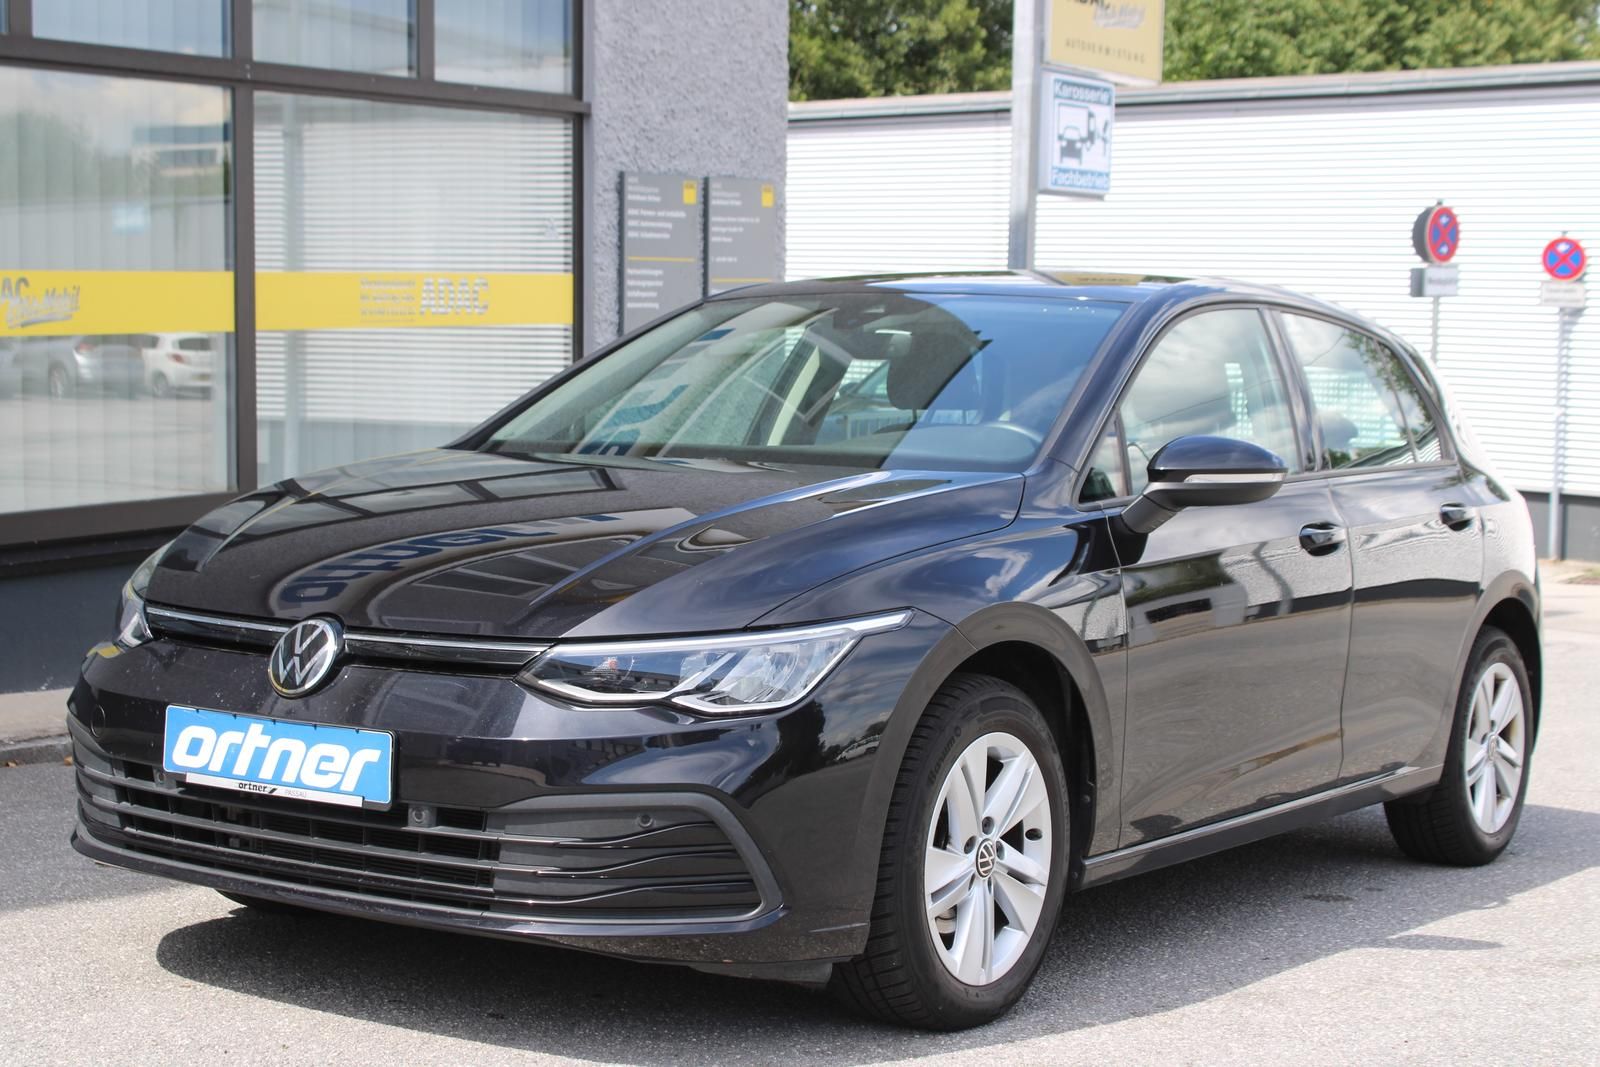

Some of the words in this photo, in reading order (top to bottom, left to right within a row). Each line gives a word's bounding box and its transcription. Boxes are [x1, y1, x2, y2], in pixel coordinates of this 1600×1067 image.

[1054, 81, 1111, 104] Karosserie
[420, 277, 489, 315] ADAC
[172, 722, 382, 792] ortner
[238, 781, 268, 794] ortner
[284, 789, 308, 799] PASSAU
